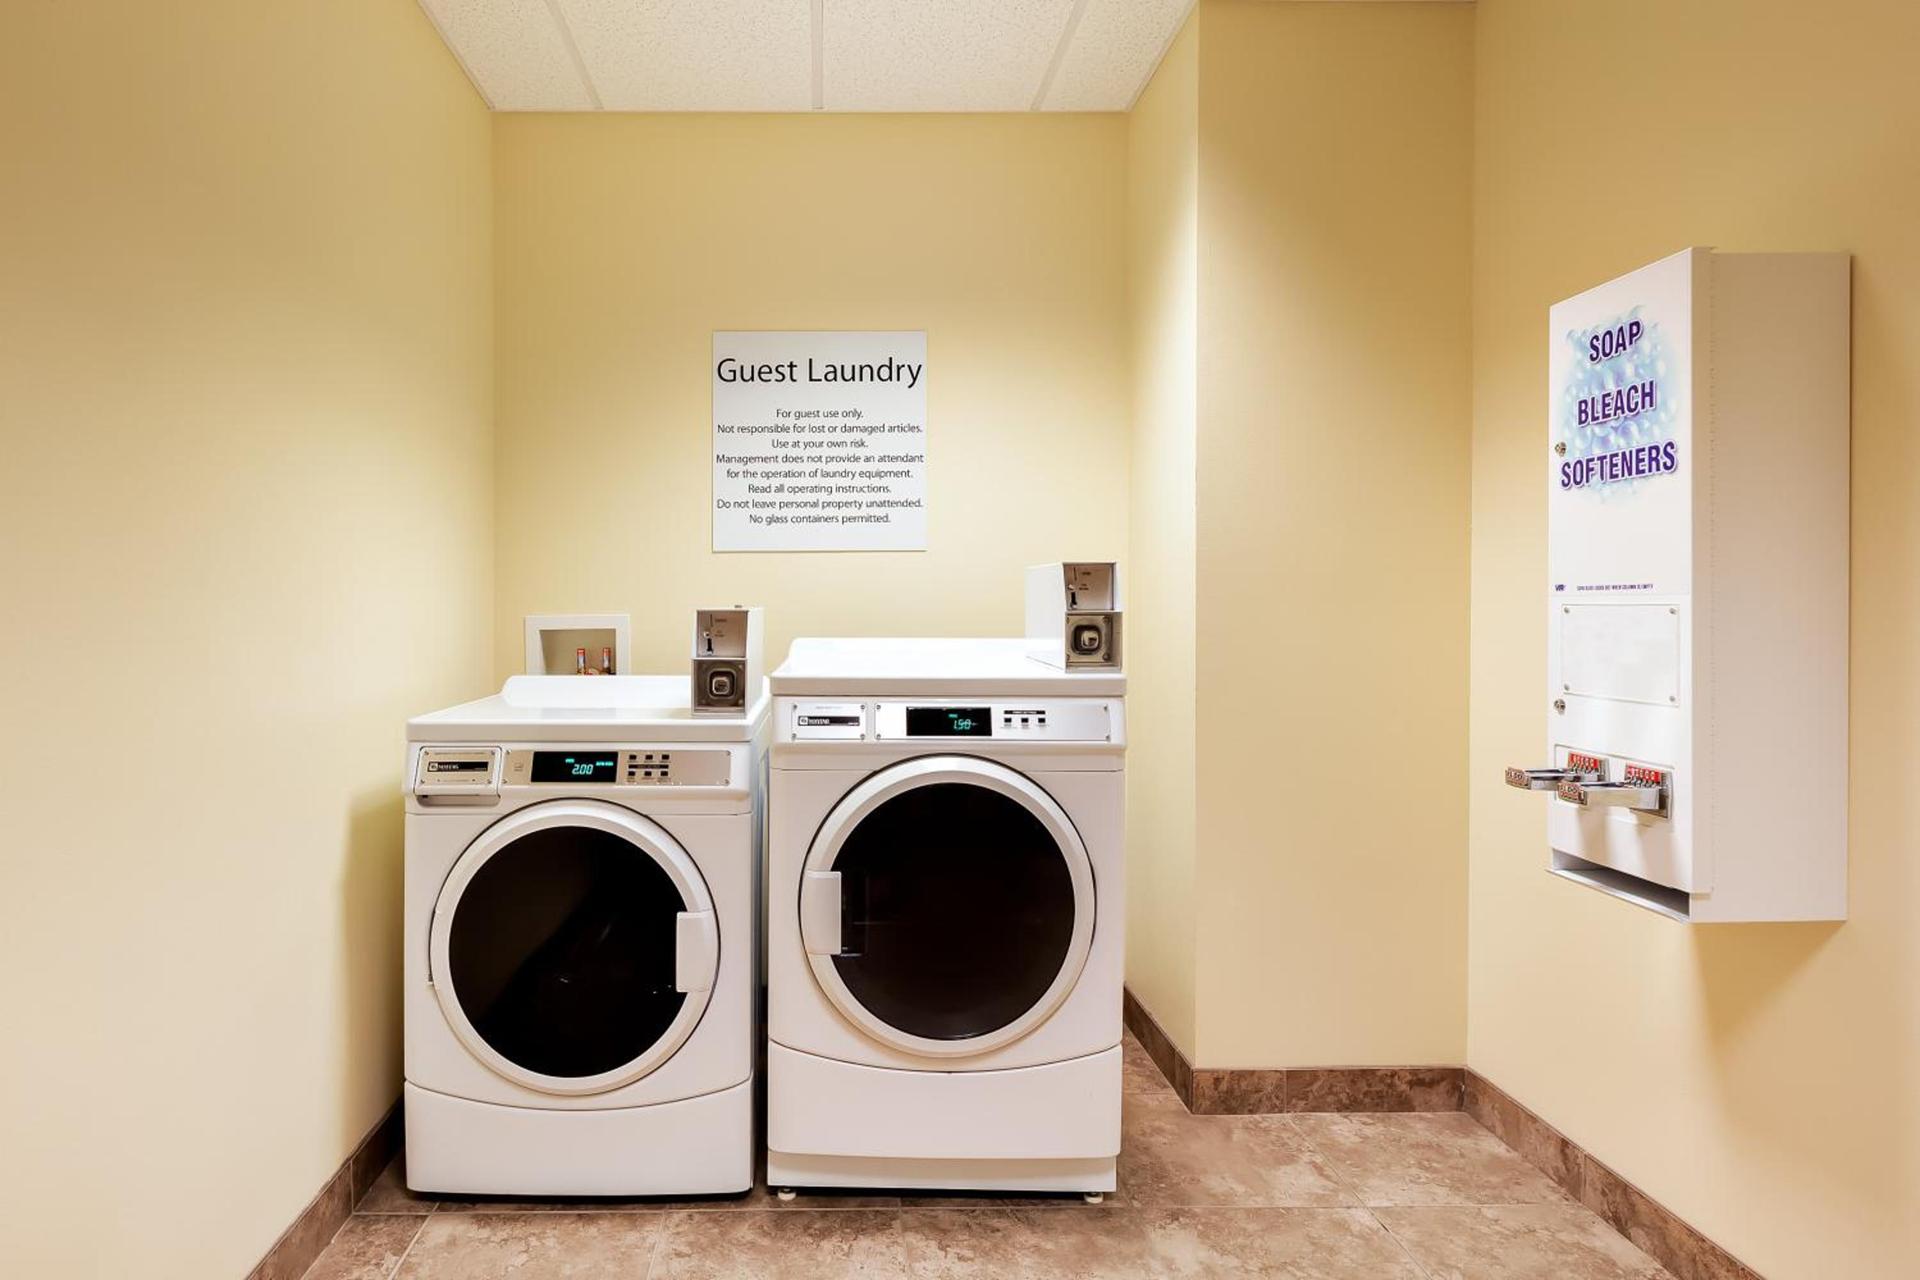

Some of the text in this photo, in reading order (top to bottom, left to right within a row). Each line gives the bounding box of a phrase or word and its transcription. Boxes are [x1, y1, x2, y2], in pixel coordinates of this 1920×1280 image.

[1589, 319, 1643, 363] SOAP
[717, 356, 922, 389] Guest Laundry
[1577, 380, 1656, 426] BLEACH
[776, 408, 864, 420] For guest use only.
[717, 423, 734, 434] Not
[737, 423, 790, 435] responsible
[792, 423, 807, 433] for
[808, 422, 826, 433] lost
[840, 423, 885, 435] damaged
[888, 423, 923, 433] articles.
[771, 438, 789, 448] Use
[791, 439, 801, 448] at
[803, 441, 824, 451] your
[850, 438, 868, 448] risk.
[716, 453, 924, 466] Management does not provide an attendant
[1560, 441, 1677, 488] SOFTENERS
[727, 468, 913, 480] for the operation of laundry equipment.
[748, 483, 891, 496] Read all operating instructions.
[717, 499, 923, 511] Do not leave personal property unattended.
[749, 513, 891, 525] No glass containers permitted.
